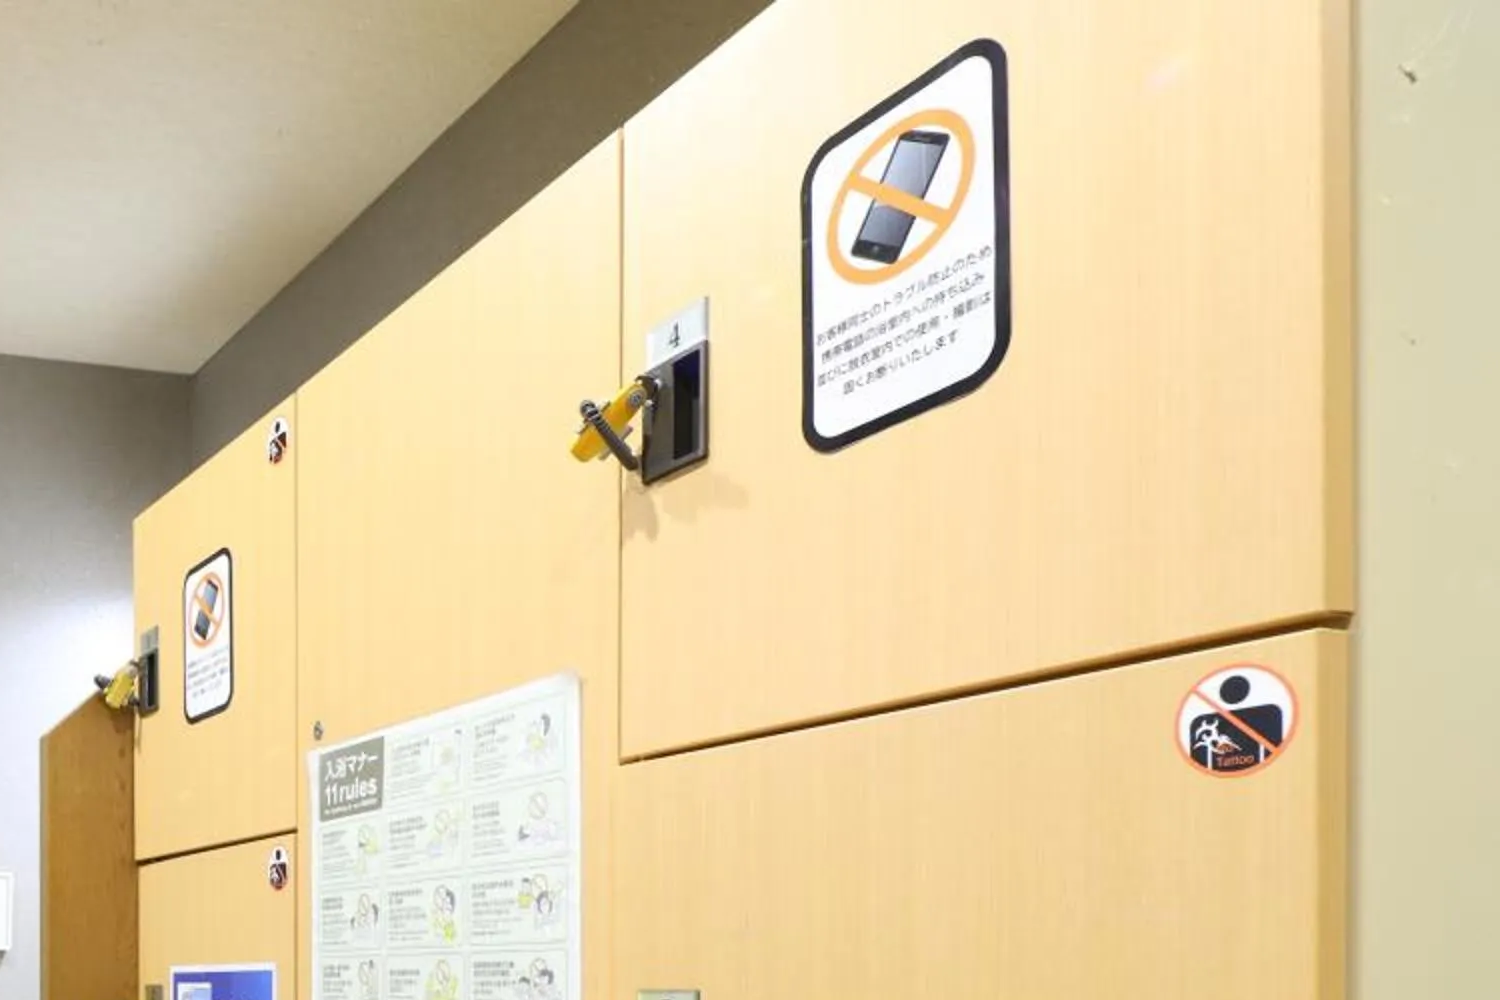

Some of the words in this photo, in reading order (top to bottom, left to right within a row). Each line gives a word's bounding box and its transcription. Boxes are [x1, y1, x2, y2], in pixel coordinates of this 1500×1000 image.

[668, 320, 681, 348] 4
[324, 751, 378, 783] 入浴マナー
